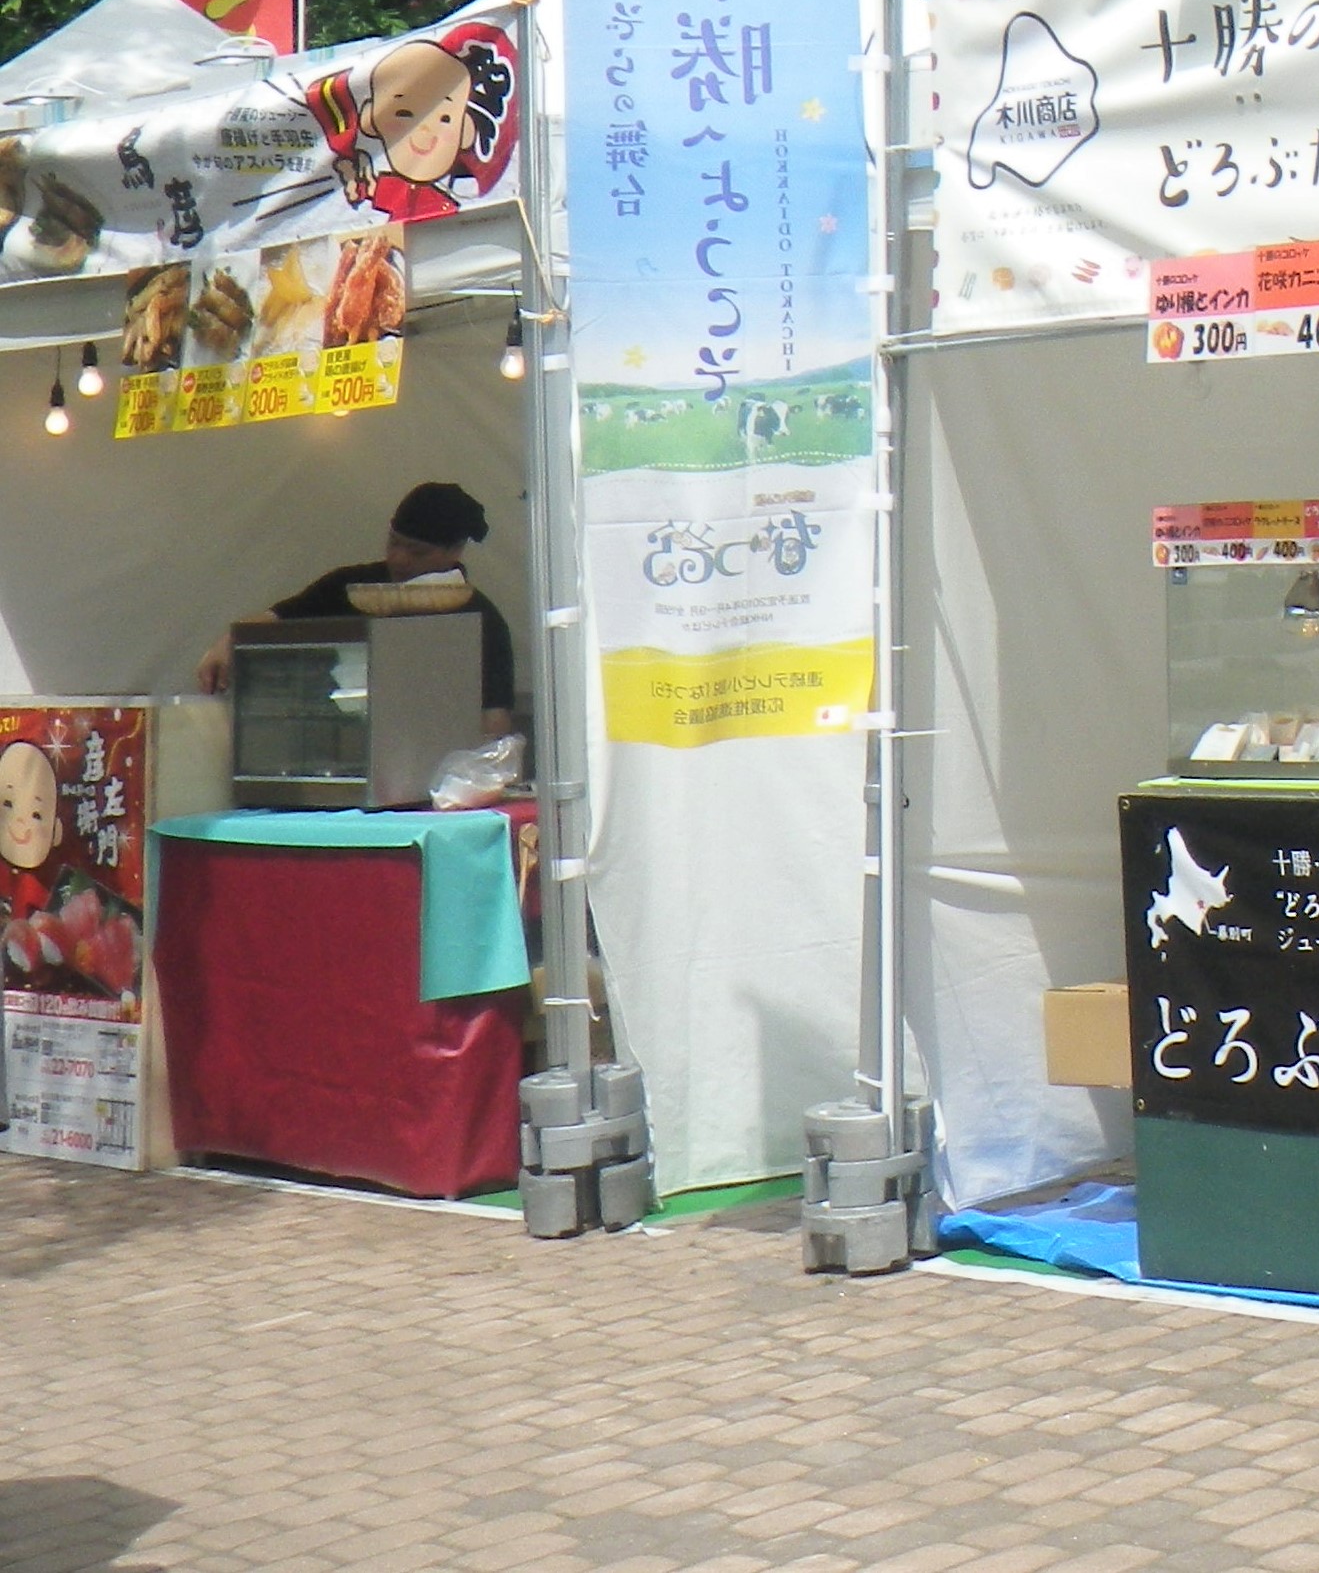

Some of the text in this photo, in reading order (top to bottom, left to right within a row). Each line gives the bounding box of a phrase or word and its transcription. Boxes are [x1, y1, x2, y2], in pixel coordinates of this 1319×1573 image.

[996, 91, 1078, 129] 木川商店
[1155, 288, 1250, 316] ゆり根とインカ
[1192, 321, 1248, 355] 300円
[248, 386, 288, 418] 300円
[330, 376, 375, 406] 500円
